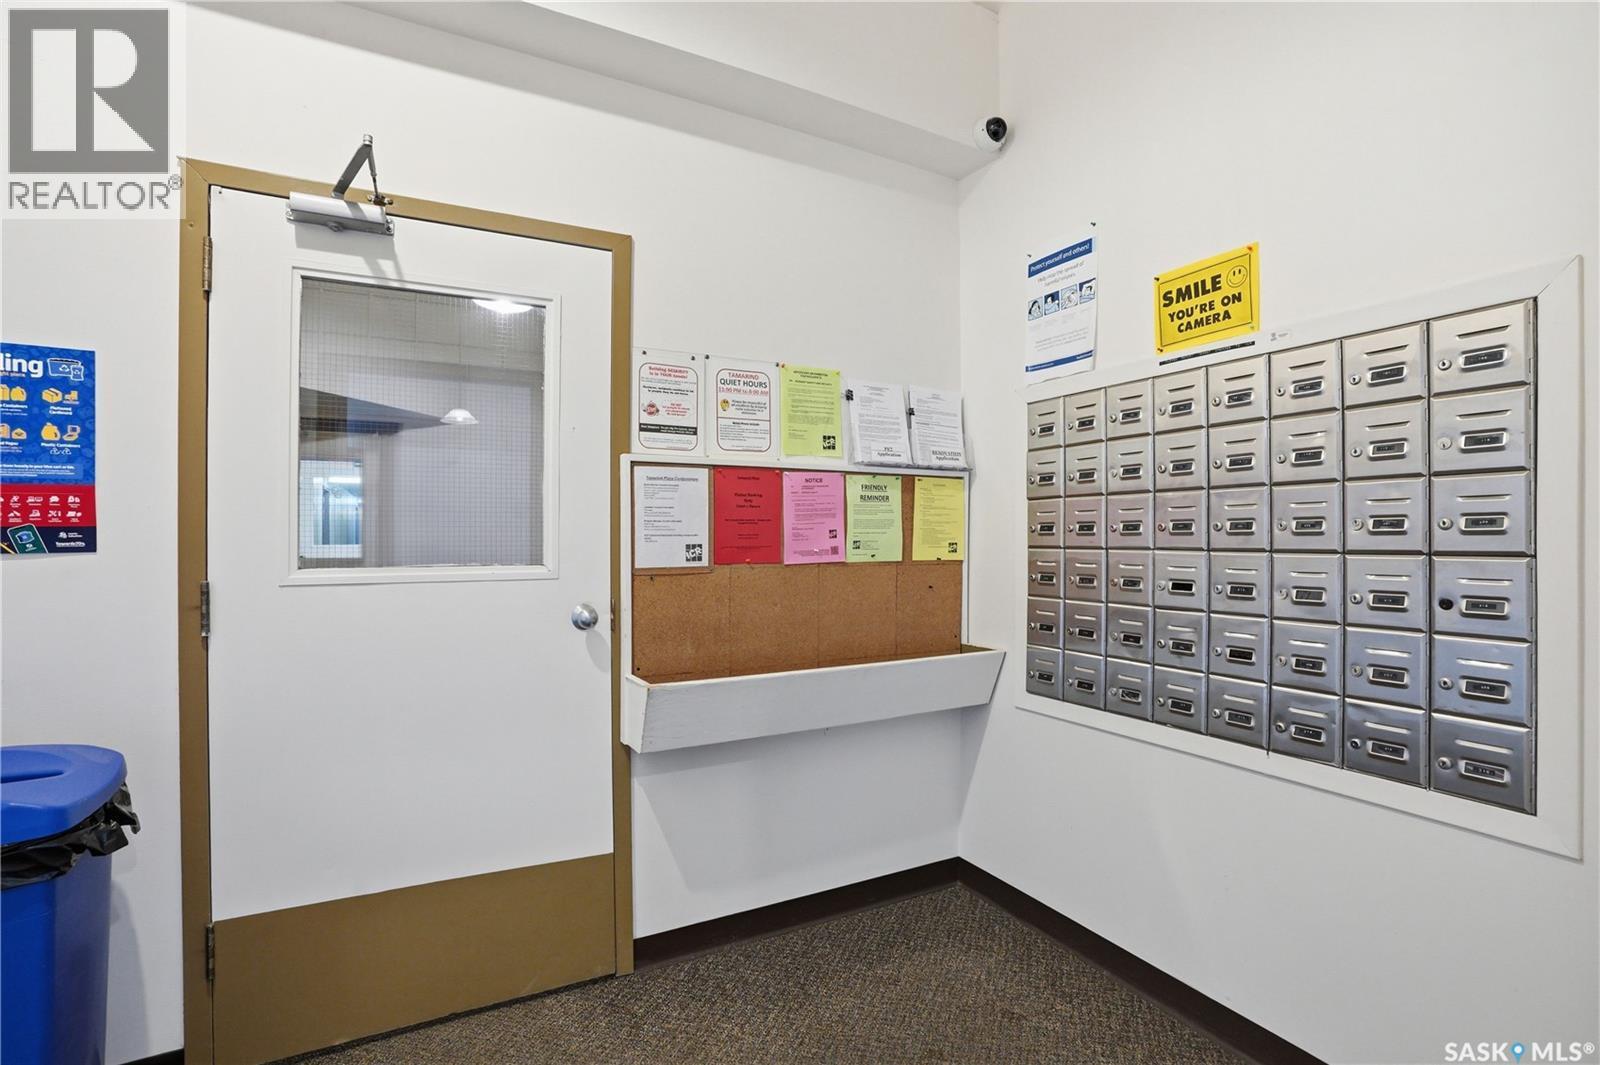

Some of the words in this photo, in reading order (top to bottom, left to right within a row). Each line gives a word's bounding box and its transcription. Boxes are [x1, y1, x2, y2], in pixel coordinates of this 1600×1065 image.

[1045, 252, 1063, 267] yourself
[1062, 249, 1073, 259] and
[1162, 273, 1222, 308] SMILE
[1168, 300, 1215, 323] YOU'RE
[1220, 292, 1242, 307] ON
[1177, 310, 1232, 333] CAMERA
[719, 378, 741, 387] QUIET
[742, 380, 768, 388] HOURS
[728, 372, 759, 381] TAMARIND
[859, 494, 890, 502] REMINDER
